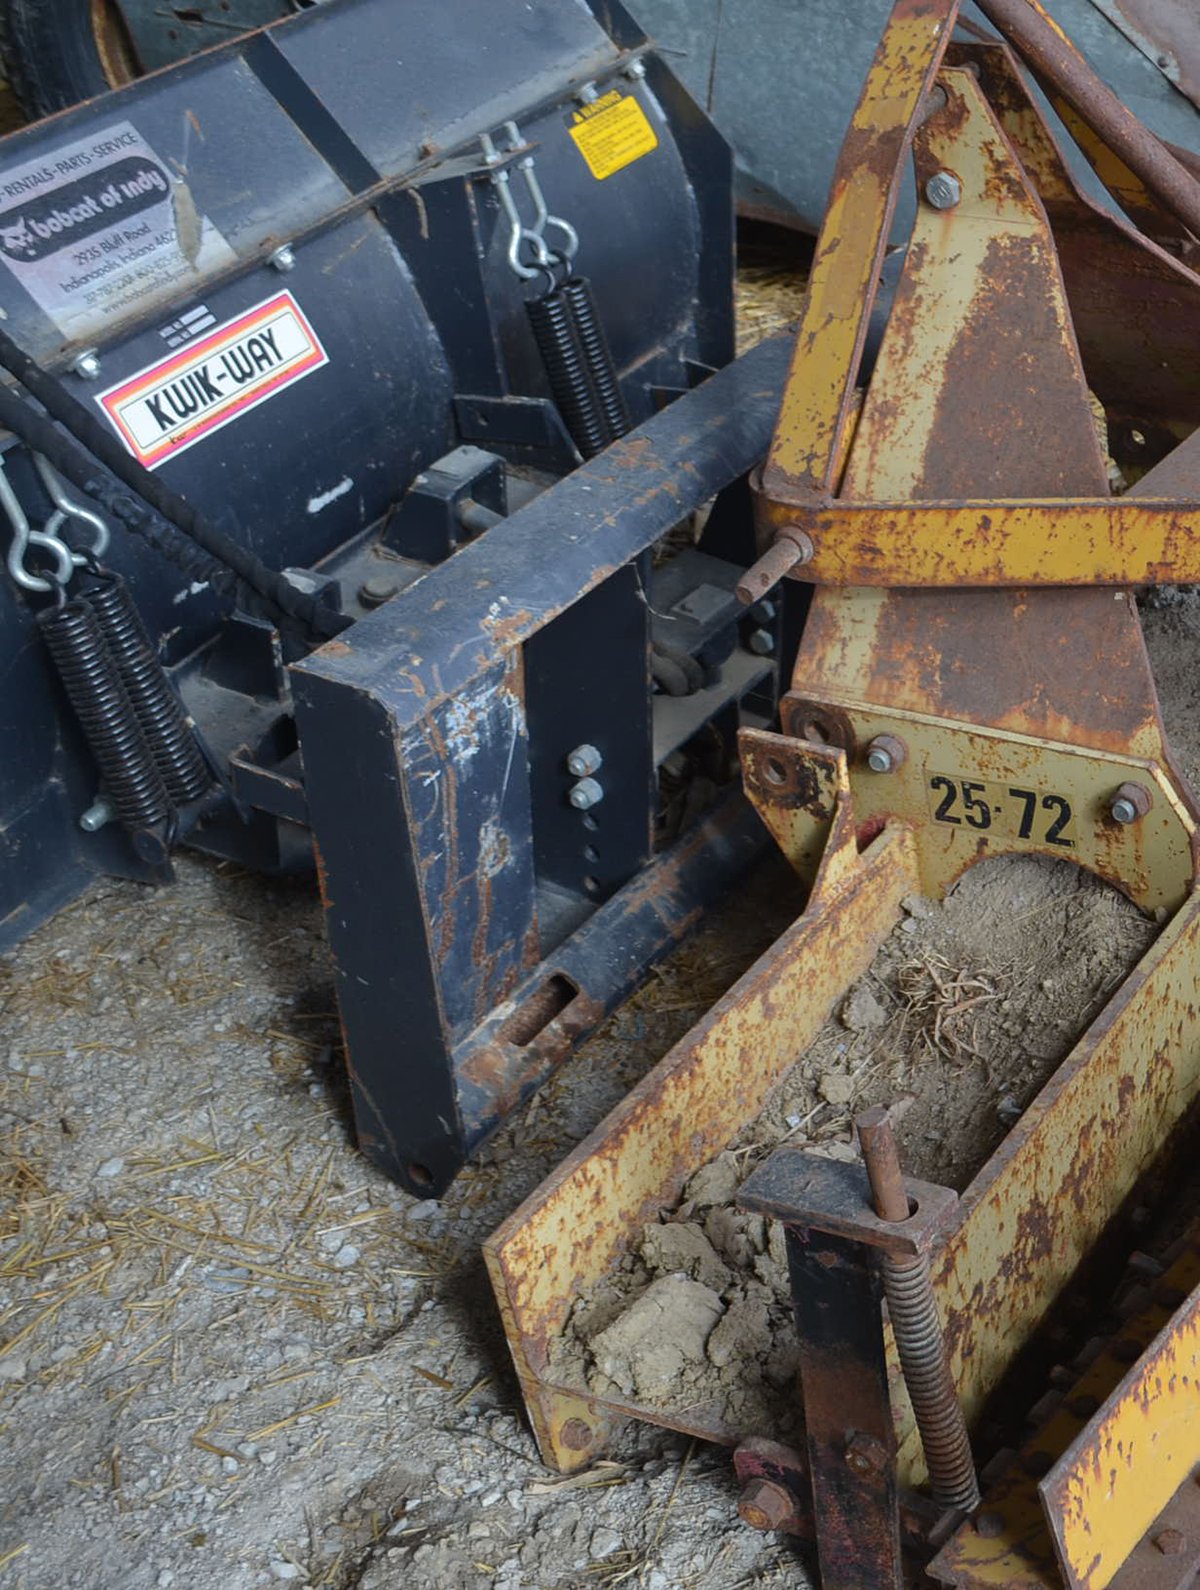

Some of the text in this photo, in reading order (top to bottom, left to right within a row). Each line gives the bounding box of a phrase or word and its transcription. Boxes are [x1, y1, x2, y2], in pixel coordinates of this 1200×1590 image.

[28, 166, 167, 239] bobcat of indy
[73, 222, 152, 266] 2935 Bluff Road
[119, 243, 155, 267] Indiana
[145, 327, 284, 432] KWIK-WAY
